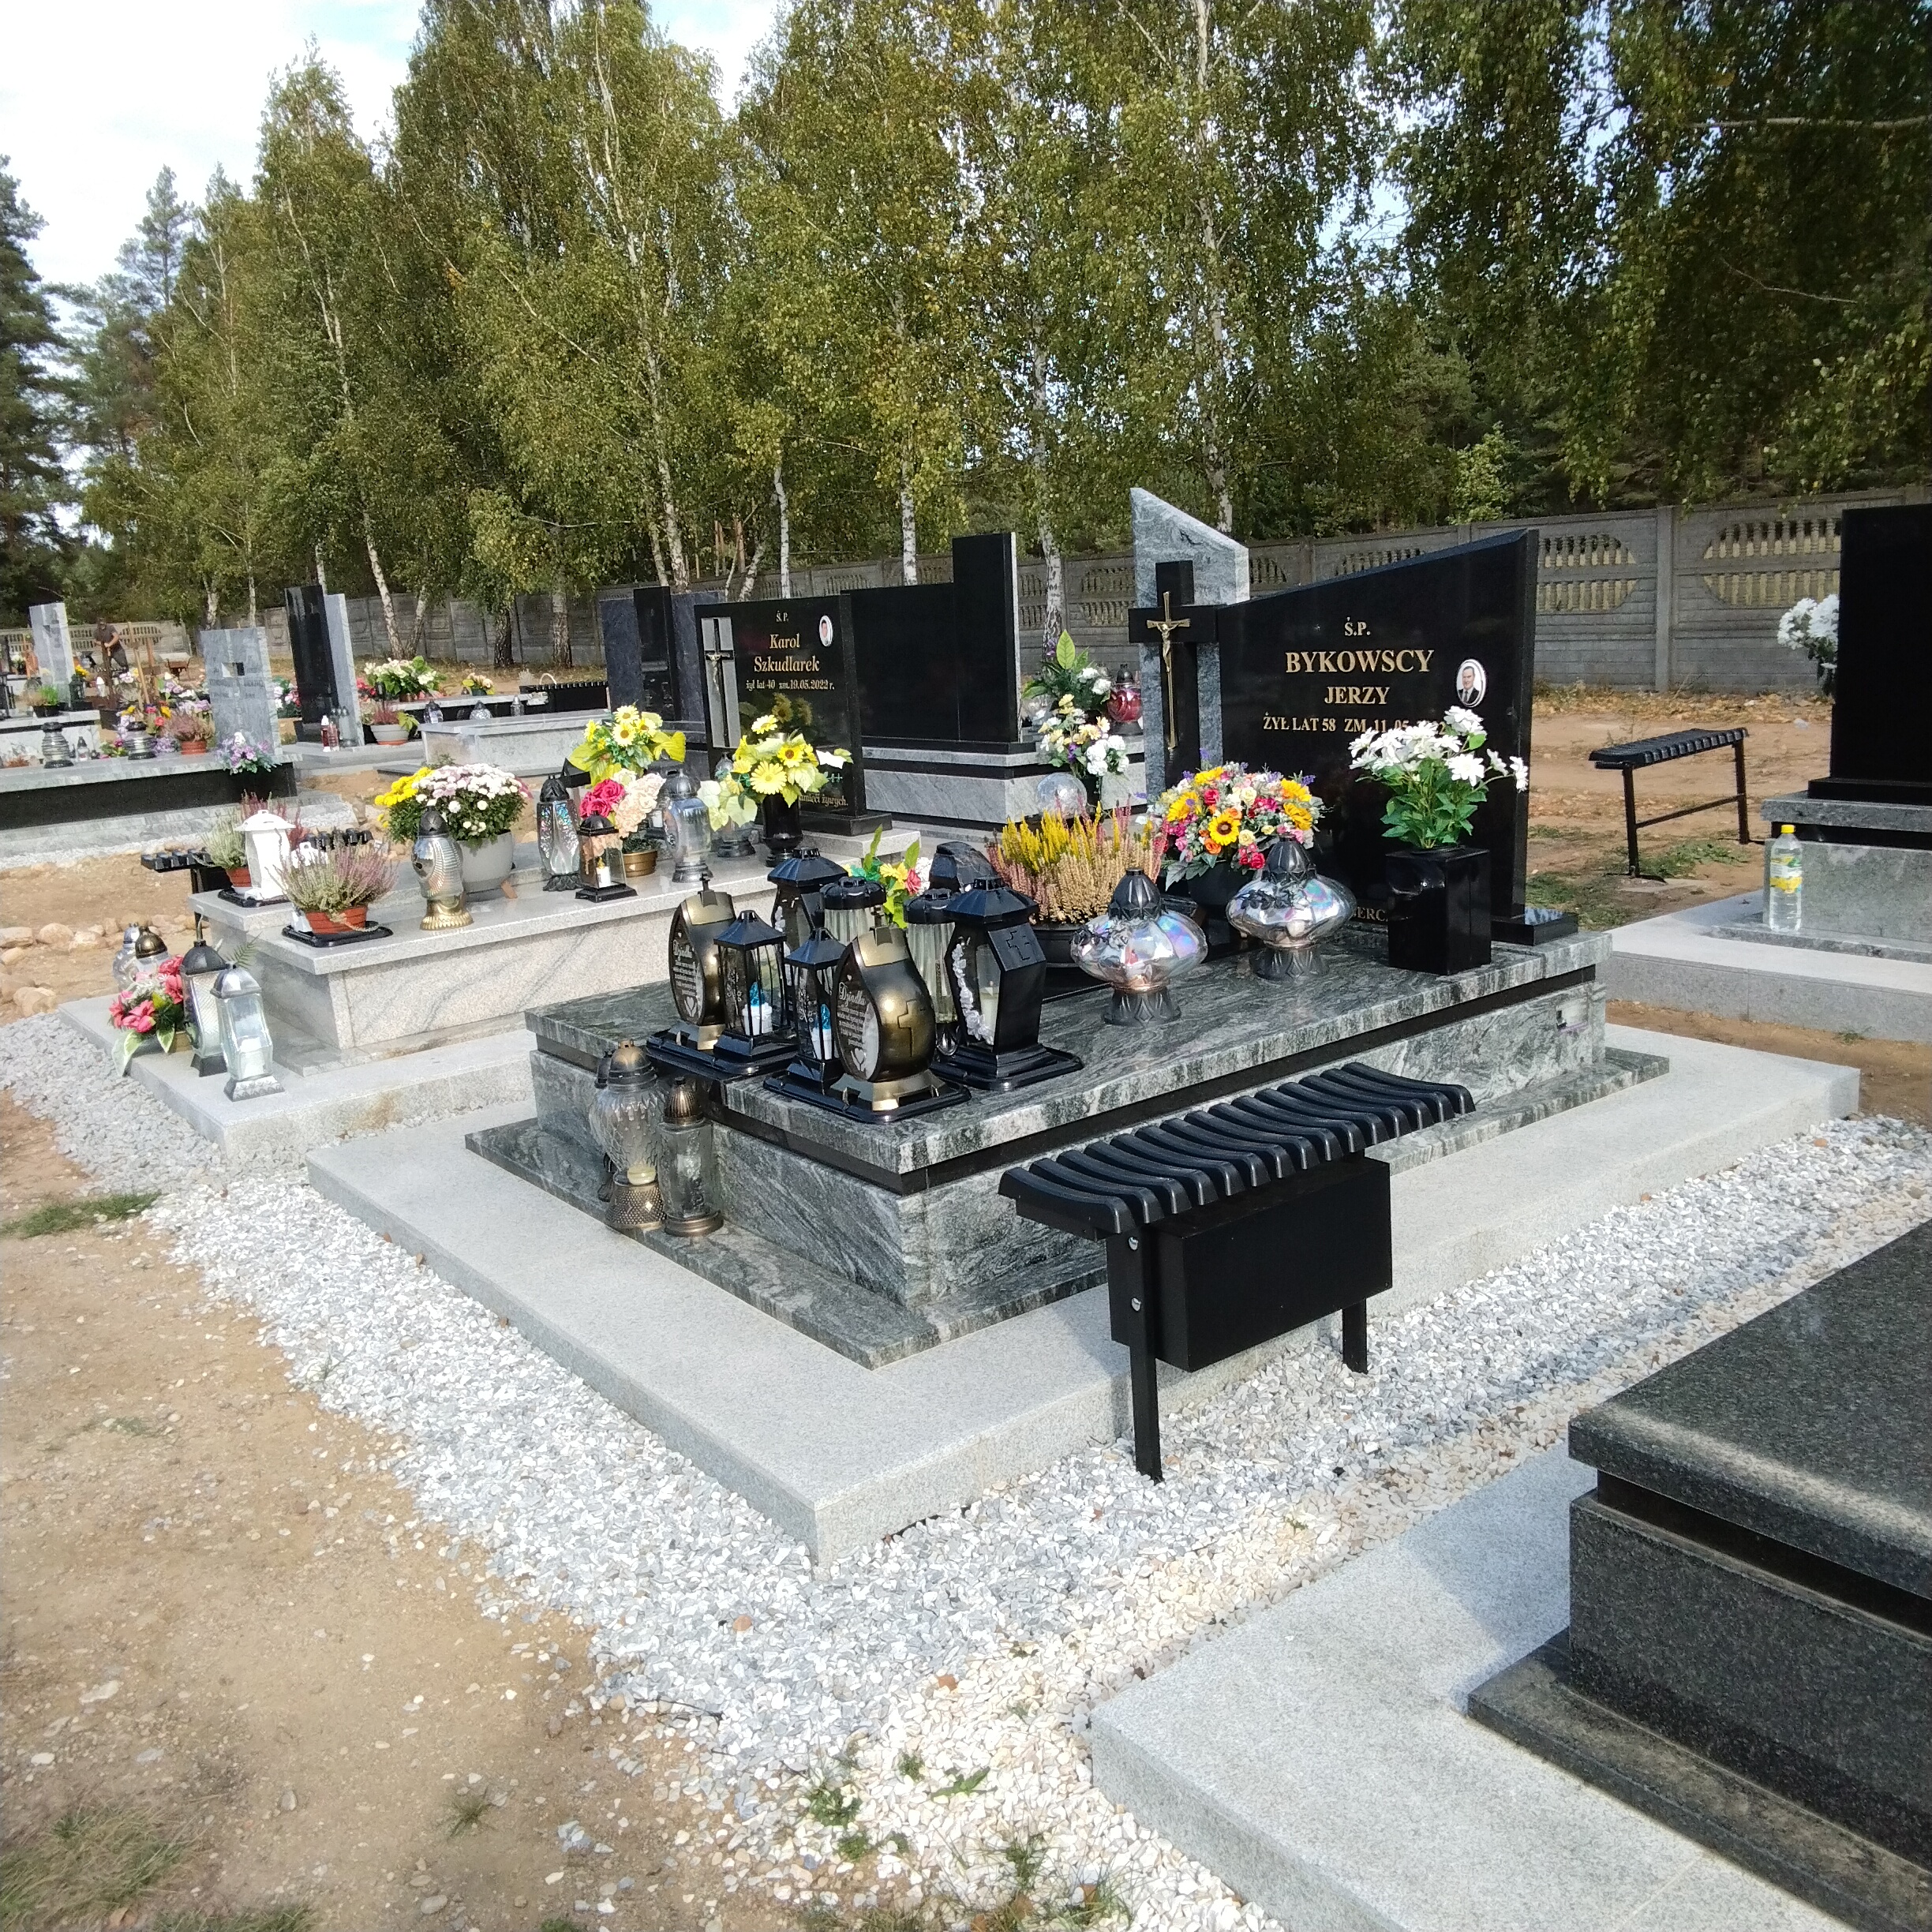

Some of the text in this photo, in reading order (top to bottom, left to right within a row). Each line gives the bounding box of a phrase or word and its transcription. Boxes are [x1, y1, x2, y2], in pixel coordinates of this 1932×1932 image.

[1344, 616, 1371, 636] Ś.P.
[769, 633, 800, 649] Karol
[754, 655, 820, 672] Szkudlarek
[1285, 650, 1435, 672] BYKOWSCY
[1324, 686, 1390, 705] JERZY
[1263, 711, 1290, 730] ŻYŁ
[1292, 717, 1319, 731] LAT
[1322, 718, 1335, 732] 58
